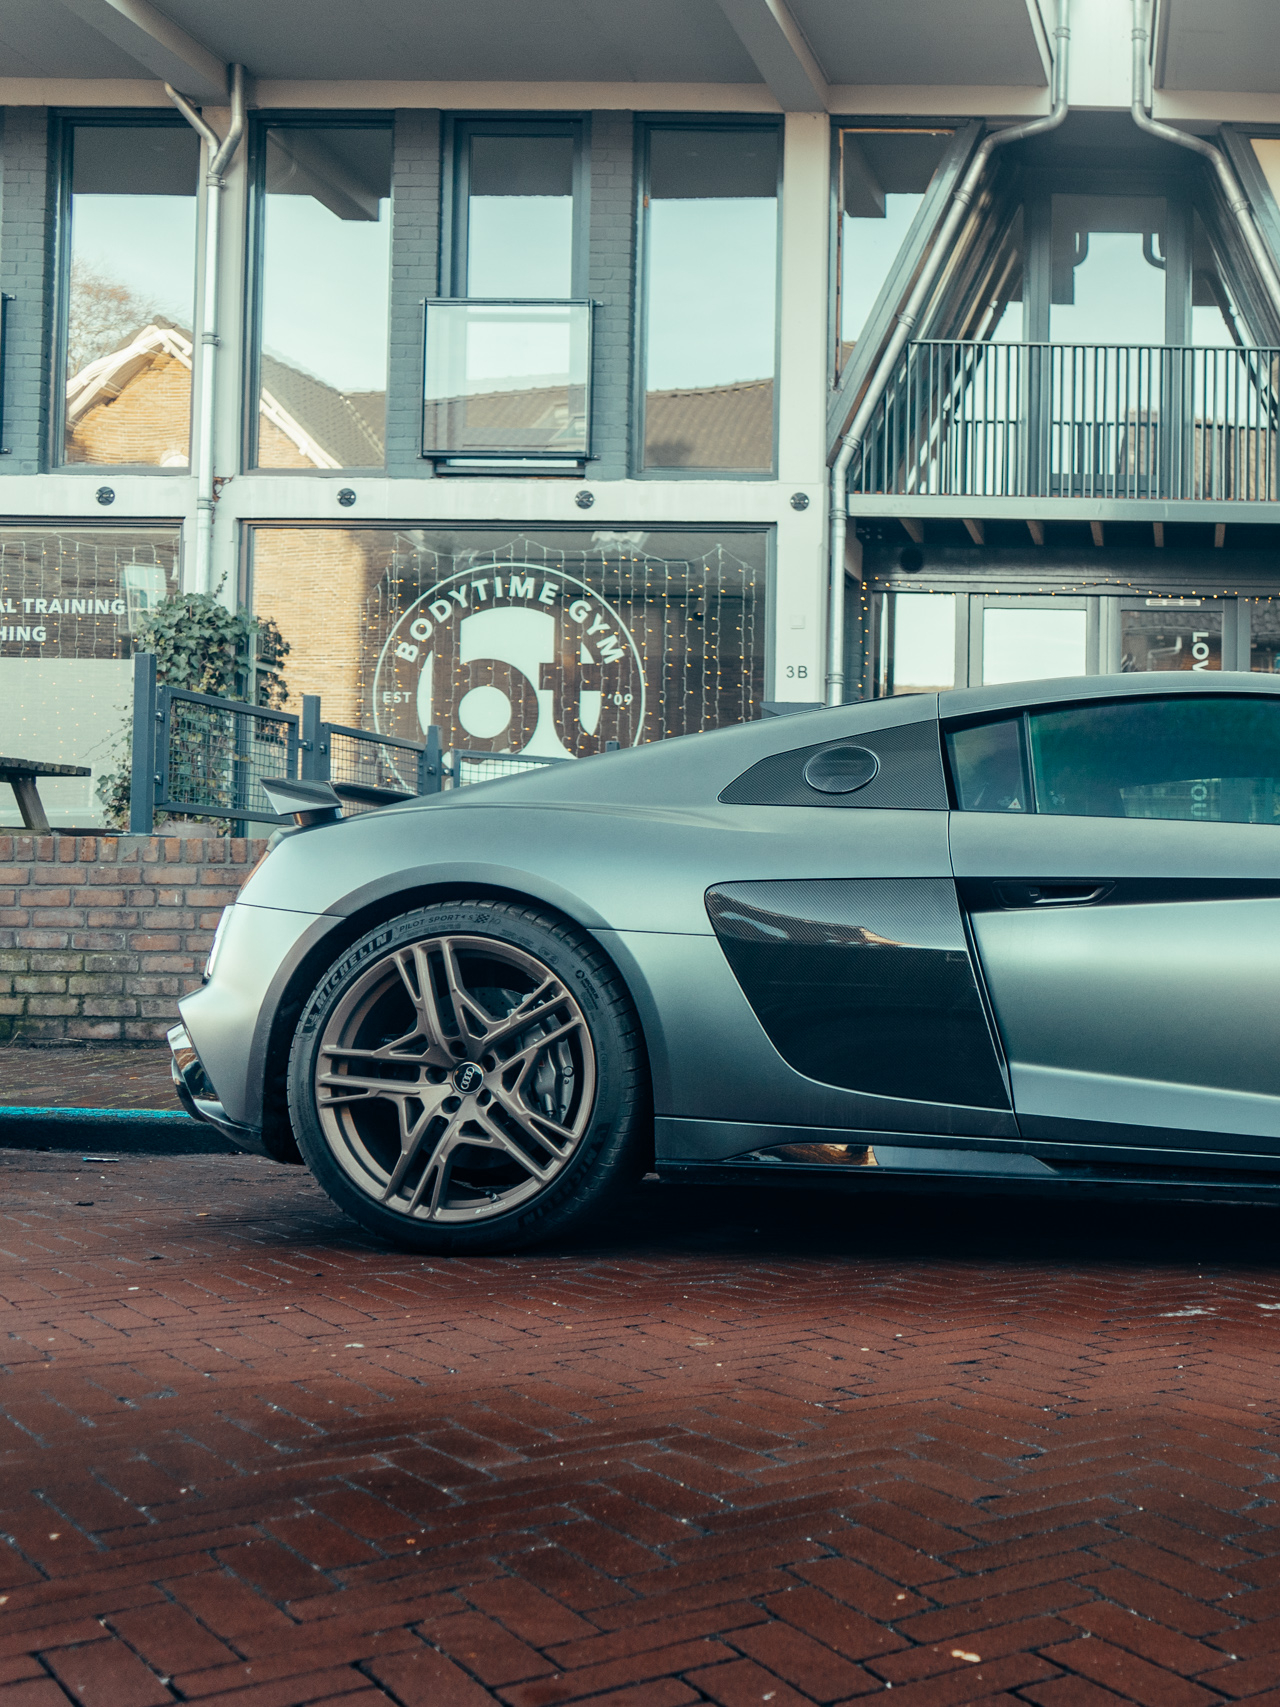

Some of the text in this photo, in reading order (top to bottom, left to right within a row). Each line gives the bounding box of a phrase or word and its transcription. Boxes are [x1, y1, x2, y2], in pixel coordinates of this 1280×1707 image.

[22, 598, 125, 615] TRAINING
[394, 575, 626, 665] BODYTIME GYM
[785, 665, 808, 679] 3B
[382, 691, 412, 704] EST
[607, 693, 634, 706] '09
[315, 932, 389, 1012] MICHELIN
[399, 918, 425, 933] PILOT
[428, 914, 461, 924] SPORT
